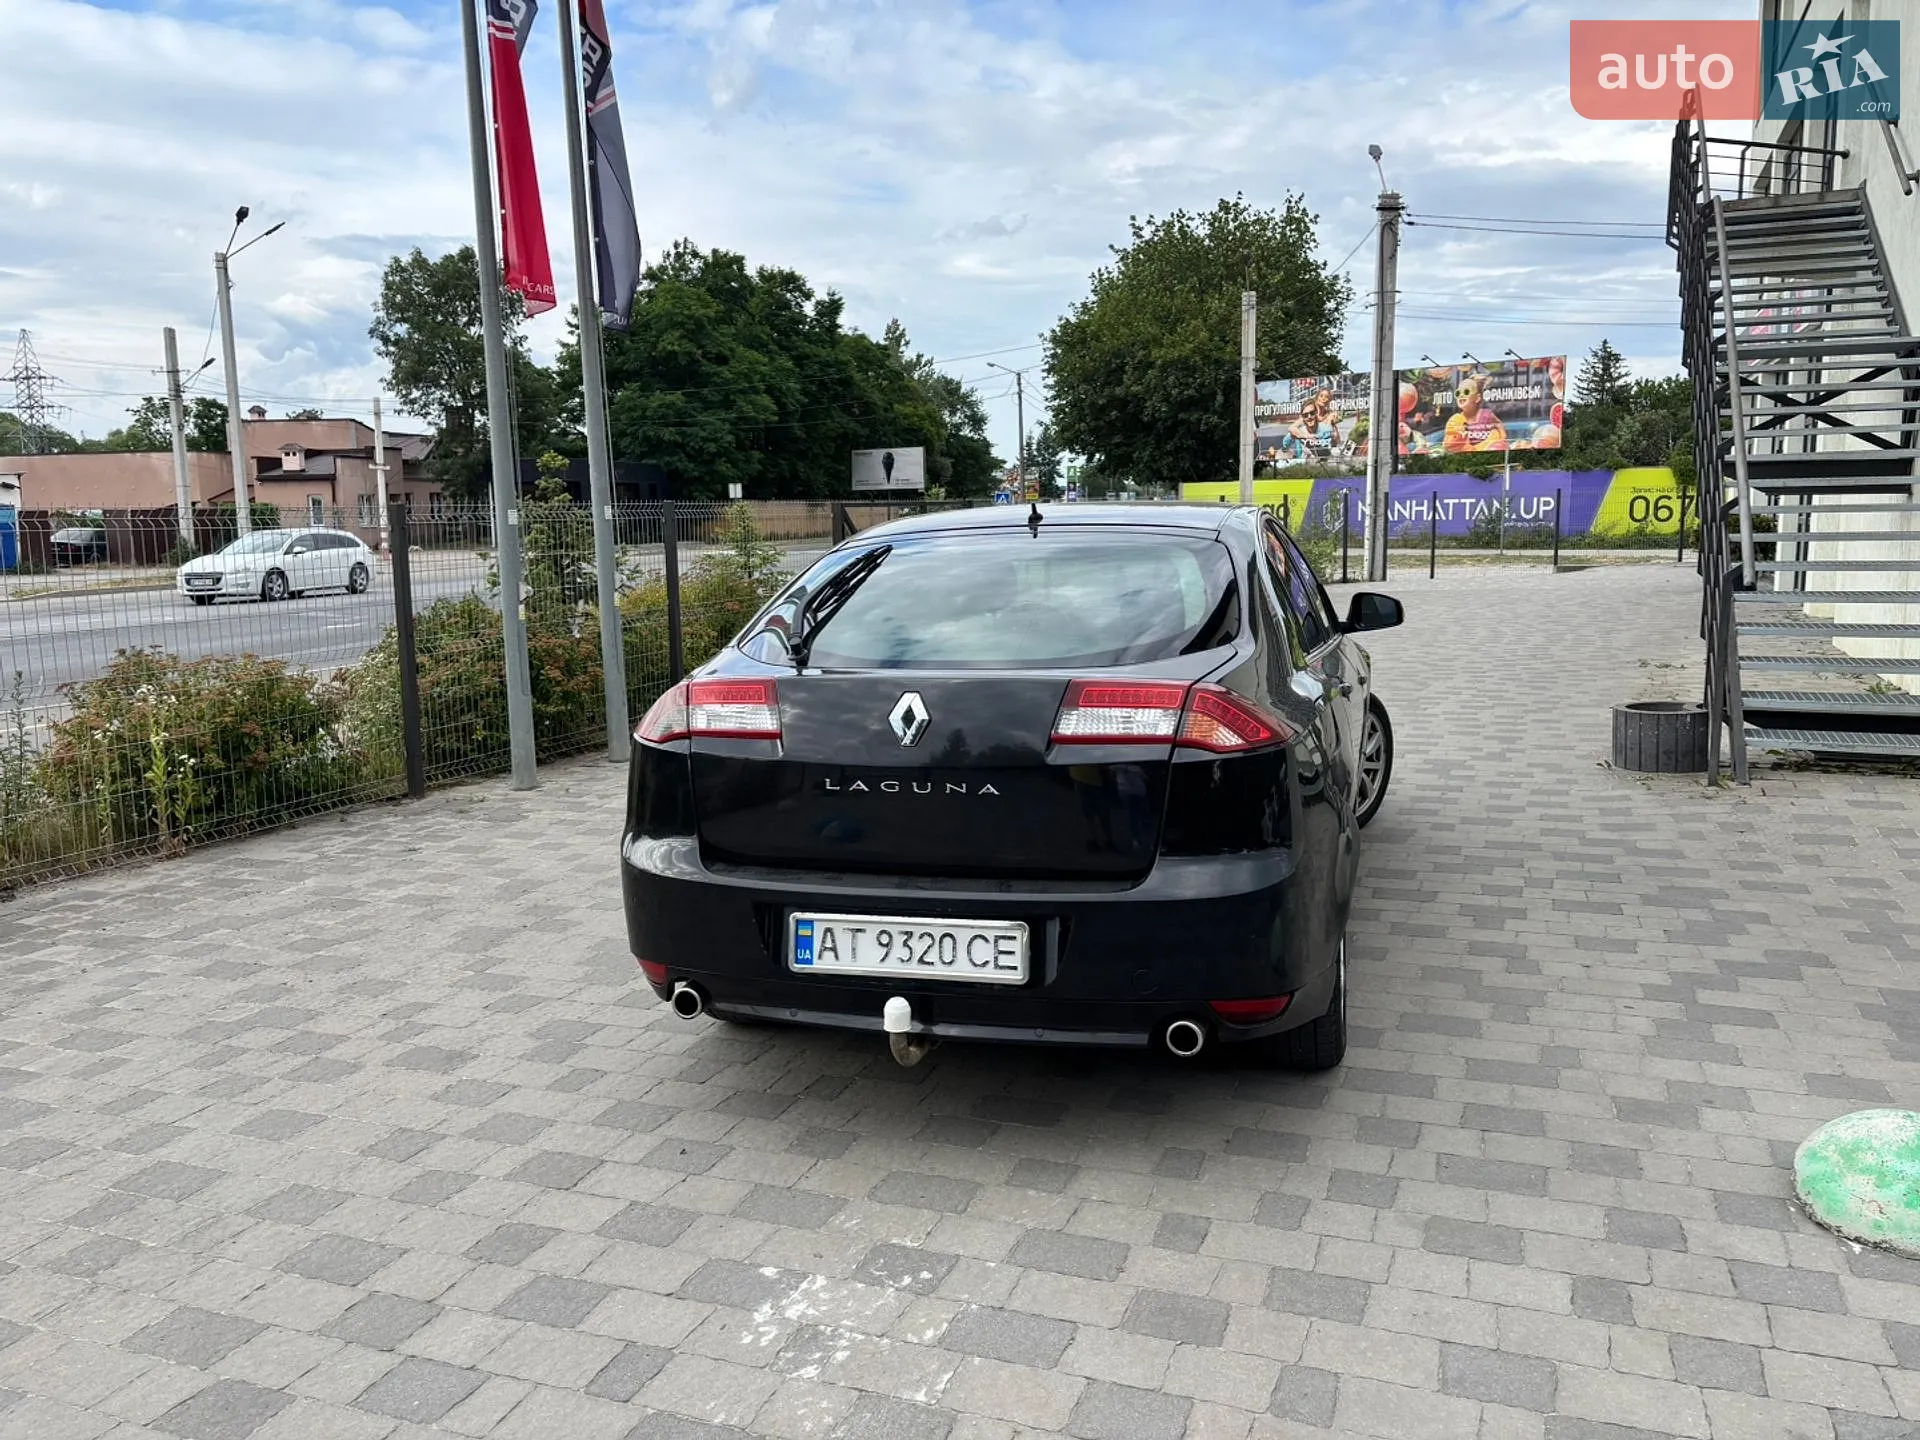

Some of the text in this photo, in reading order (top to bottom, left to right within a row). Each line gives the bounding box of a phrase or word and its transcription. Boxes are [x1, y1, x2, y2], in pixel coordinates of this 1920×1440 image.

[1482, 385, 1541, 402] ФРАНКІВСЬК
[1357, 497, 1554, 521] MNHATTAN.UP
[824, 778, 1000, 795] LAGUNA
[797, 949, 811, 960] UA
[817, 926, 1018, 971] AT 9320 CE
